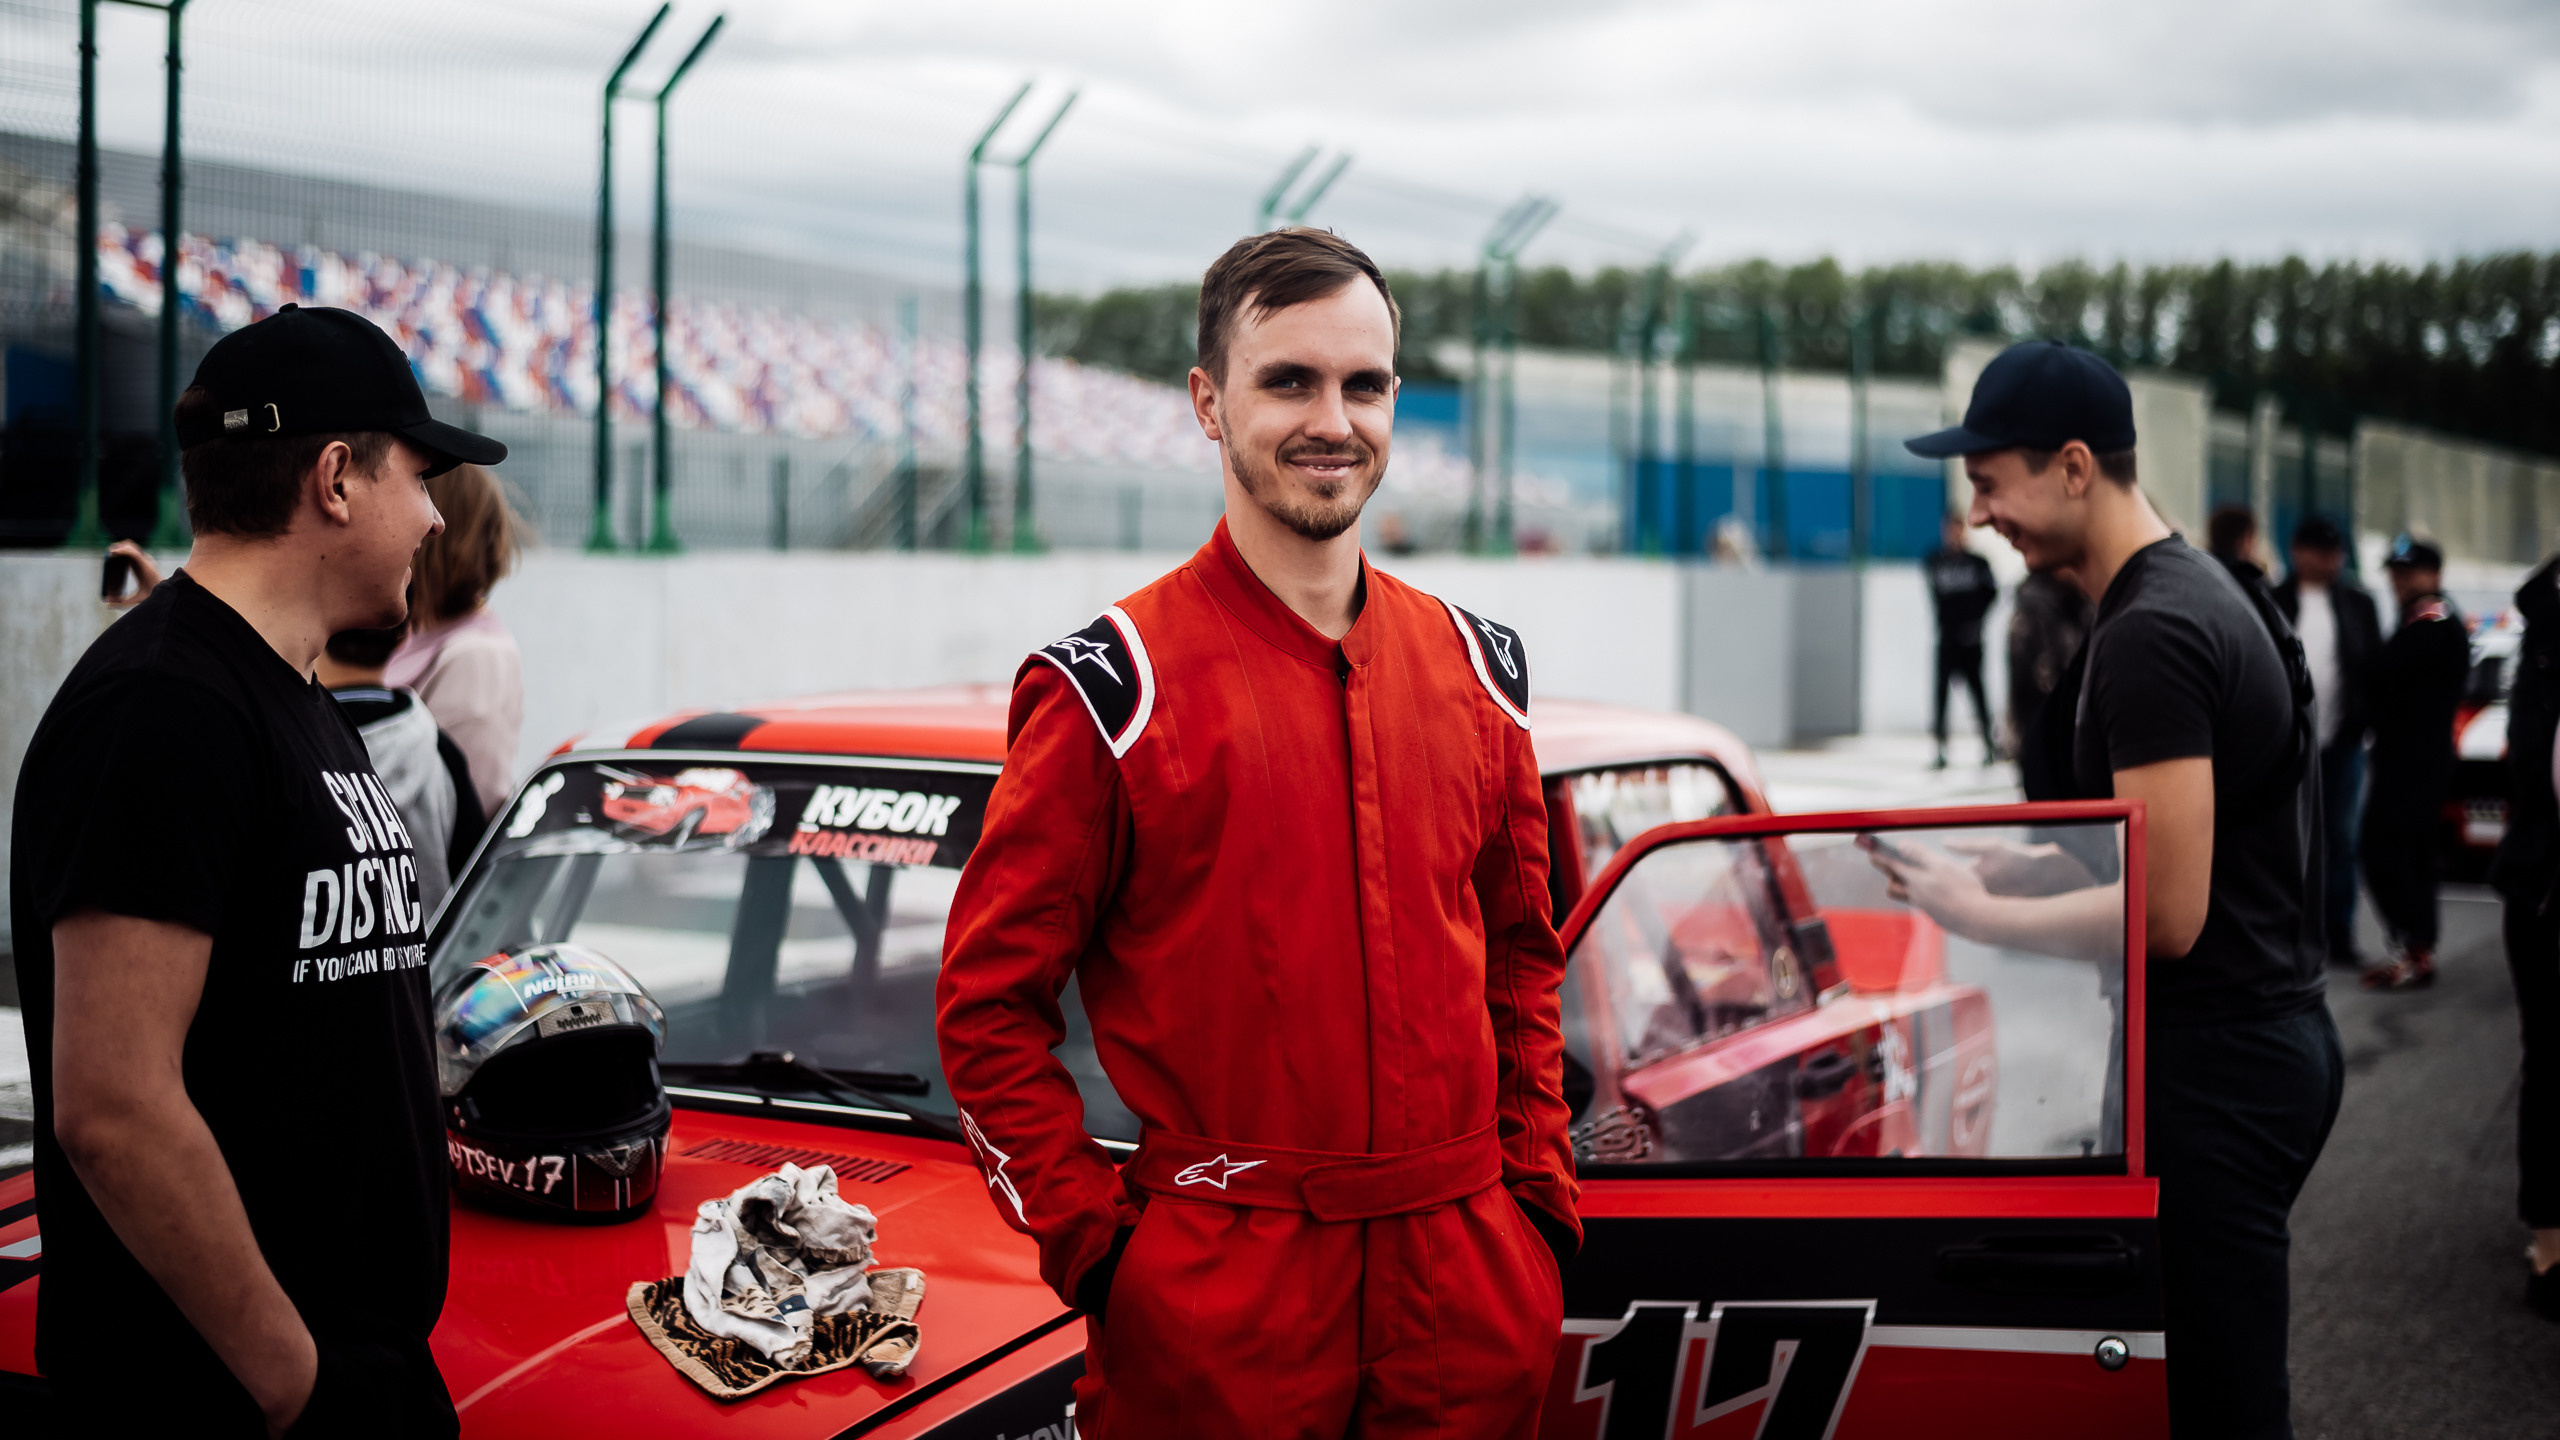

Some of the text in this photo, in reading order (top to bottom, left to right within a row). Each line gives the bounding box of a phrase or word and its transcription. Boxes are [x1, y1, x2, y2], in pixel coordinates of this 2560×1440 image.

[802, 784, 962, 836] КУБОК
[788, 829, 939, 866] КЛАССИКИ
[293, 959, 311, 982] IF
[347, 949, 378, 976] CAN
[523, 973, 596, 998] NOLAN
[1573, 1299, 1878, 1440] 17
